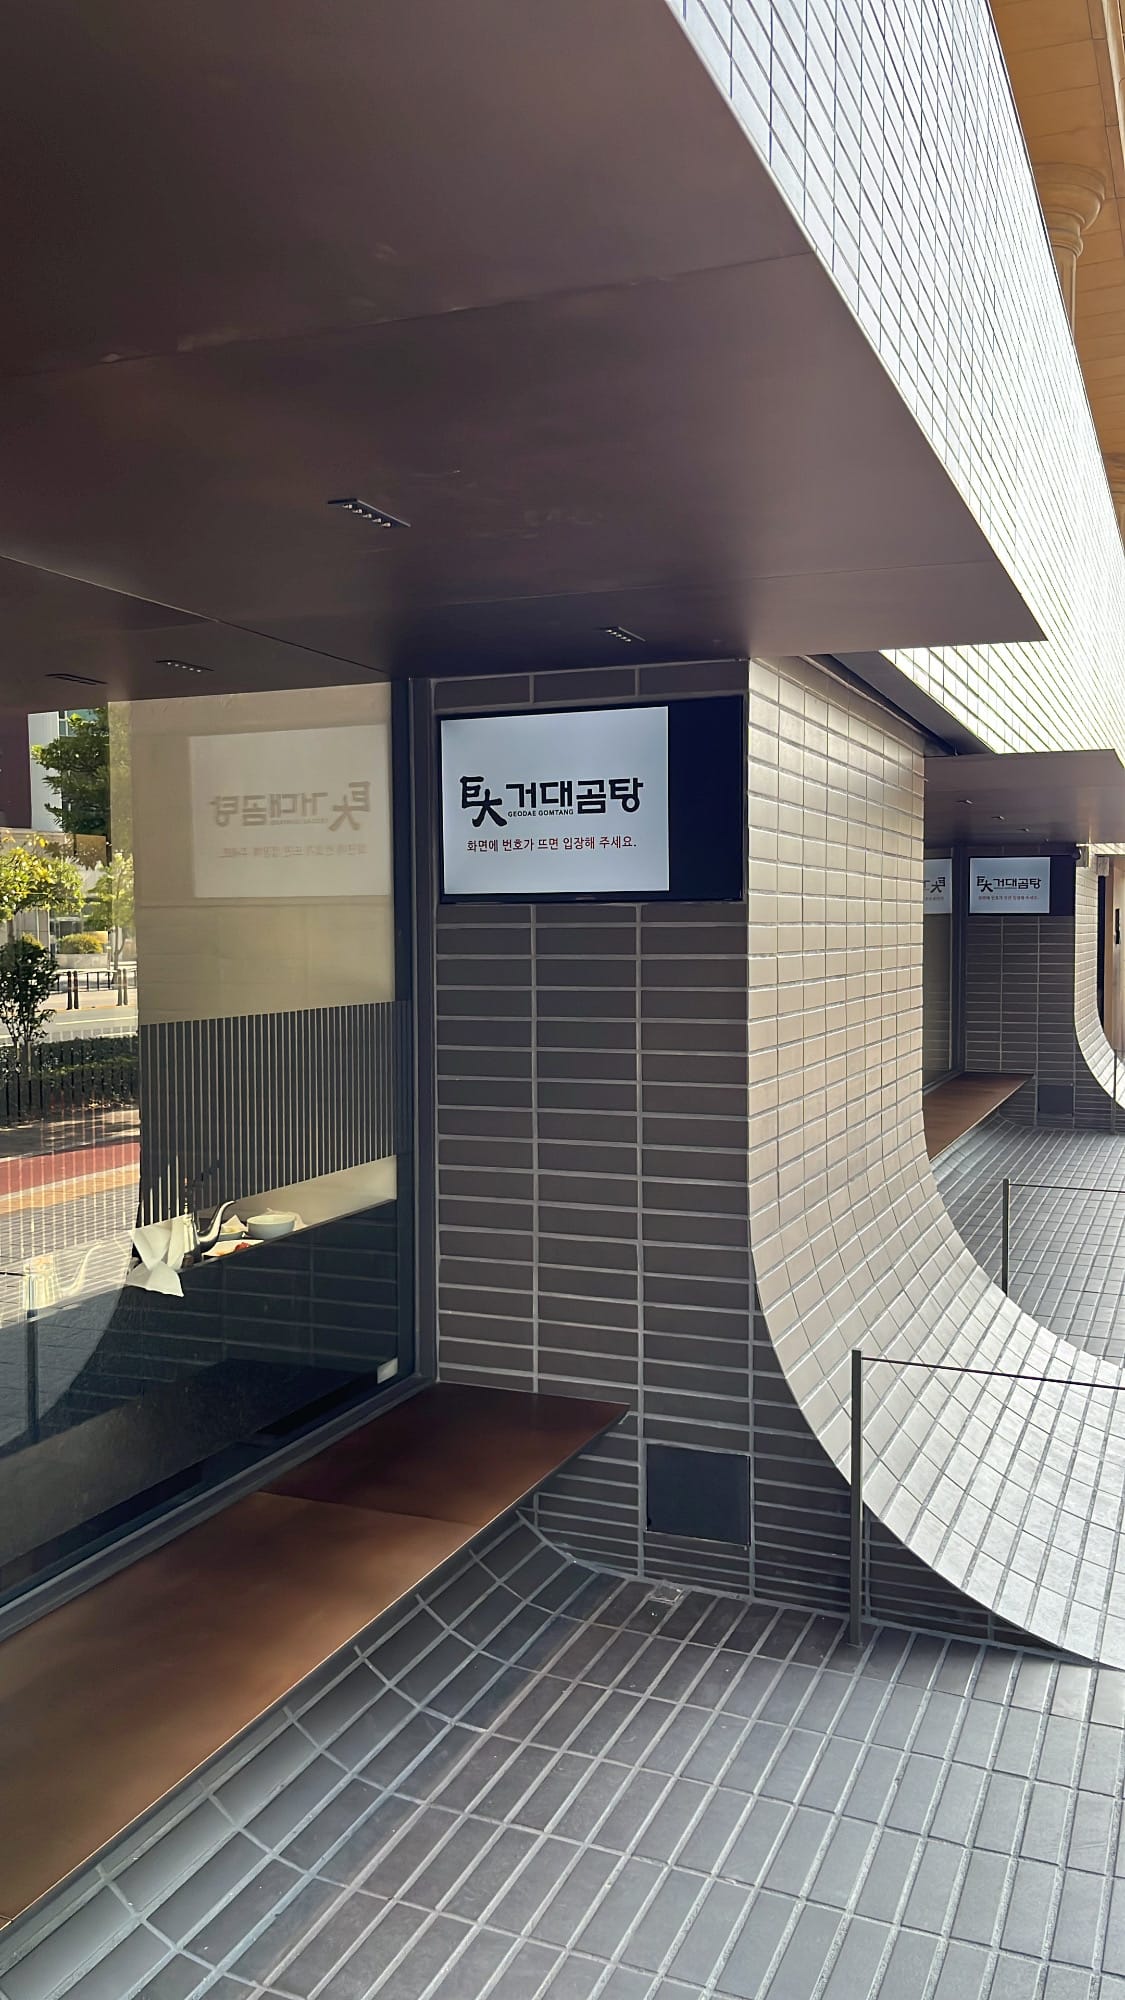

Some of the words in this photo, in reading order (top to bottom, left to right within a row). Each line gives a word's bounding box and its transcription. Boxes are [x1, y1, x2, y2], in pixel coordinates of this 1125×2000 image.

[505, 777, 644, 815] 거대곰탕
[507, 810, 537, 818] GEODAE
[538, 808, 574, 817] GOMTANG
[467, 839, 499, 853] 화면에
[502, 838, 534, 852] 번호가
[537, 838, 559, 850] 뜨면
[562, 836, 596, 850] 입장해
[599, 835, 637, 849] 주세요.
[993, 877, 1042, 890] 거대곰탕
